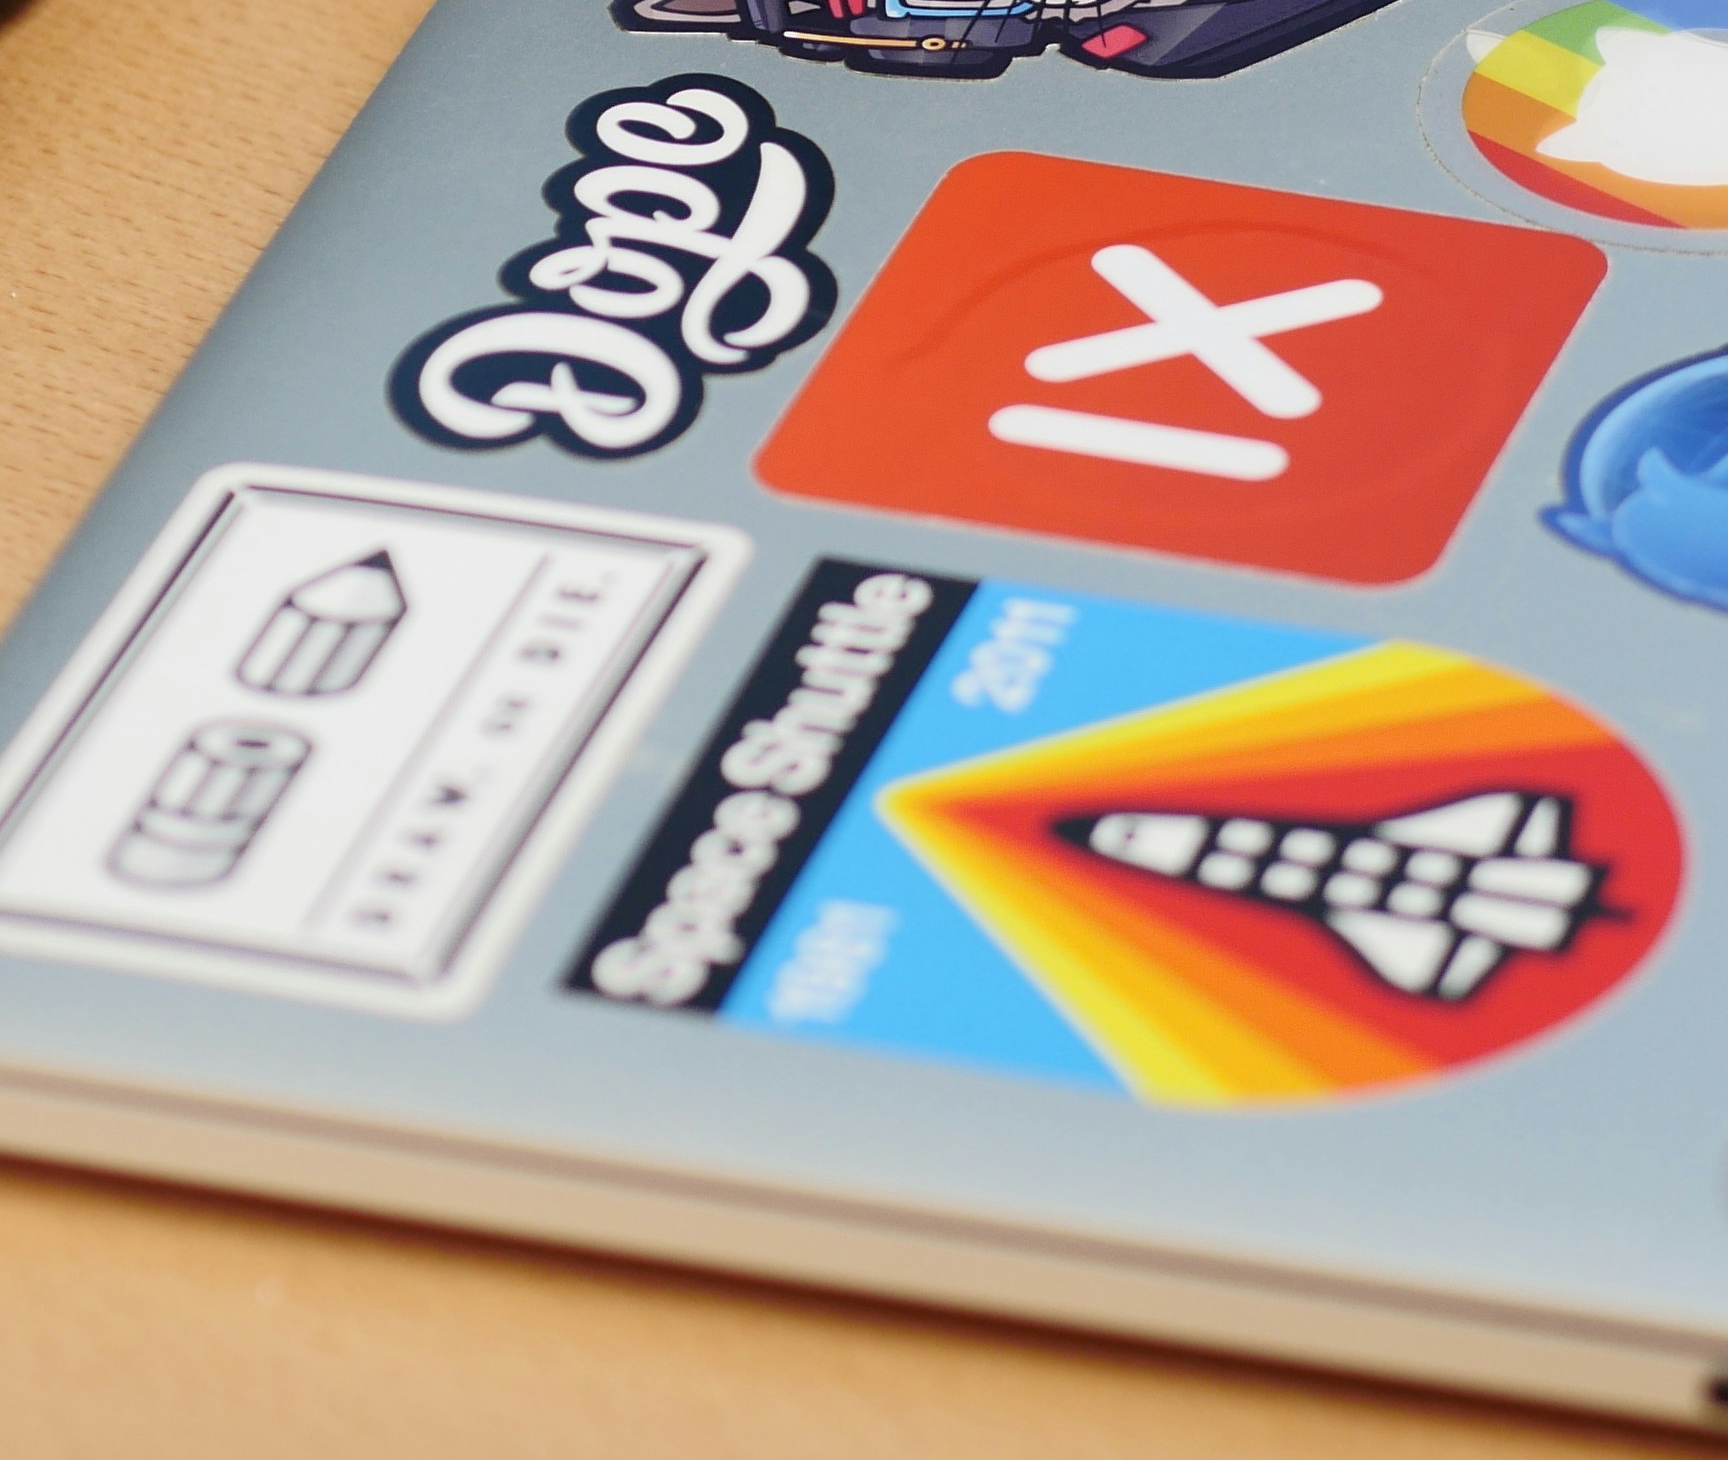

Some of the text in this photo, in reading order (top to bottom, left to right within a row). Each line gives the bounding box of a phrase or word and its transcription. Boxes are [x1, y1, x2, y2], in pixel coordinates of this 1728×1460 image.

[418, 88, 811, 449] Dope
[591, 573, 934, 1006] Space Shuttle
